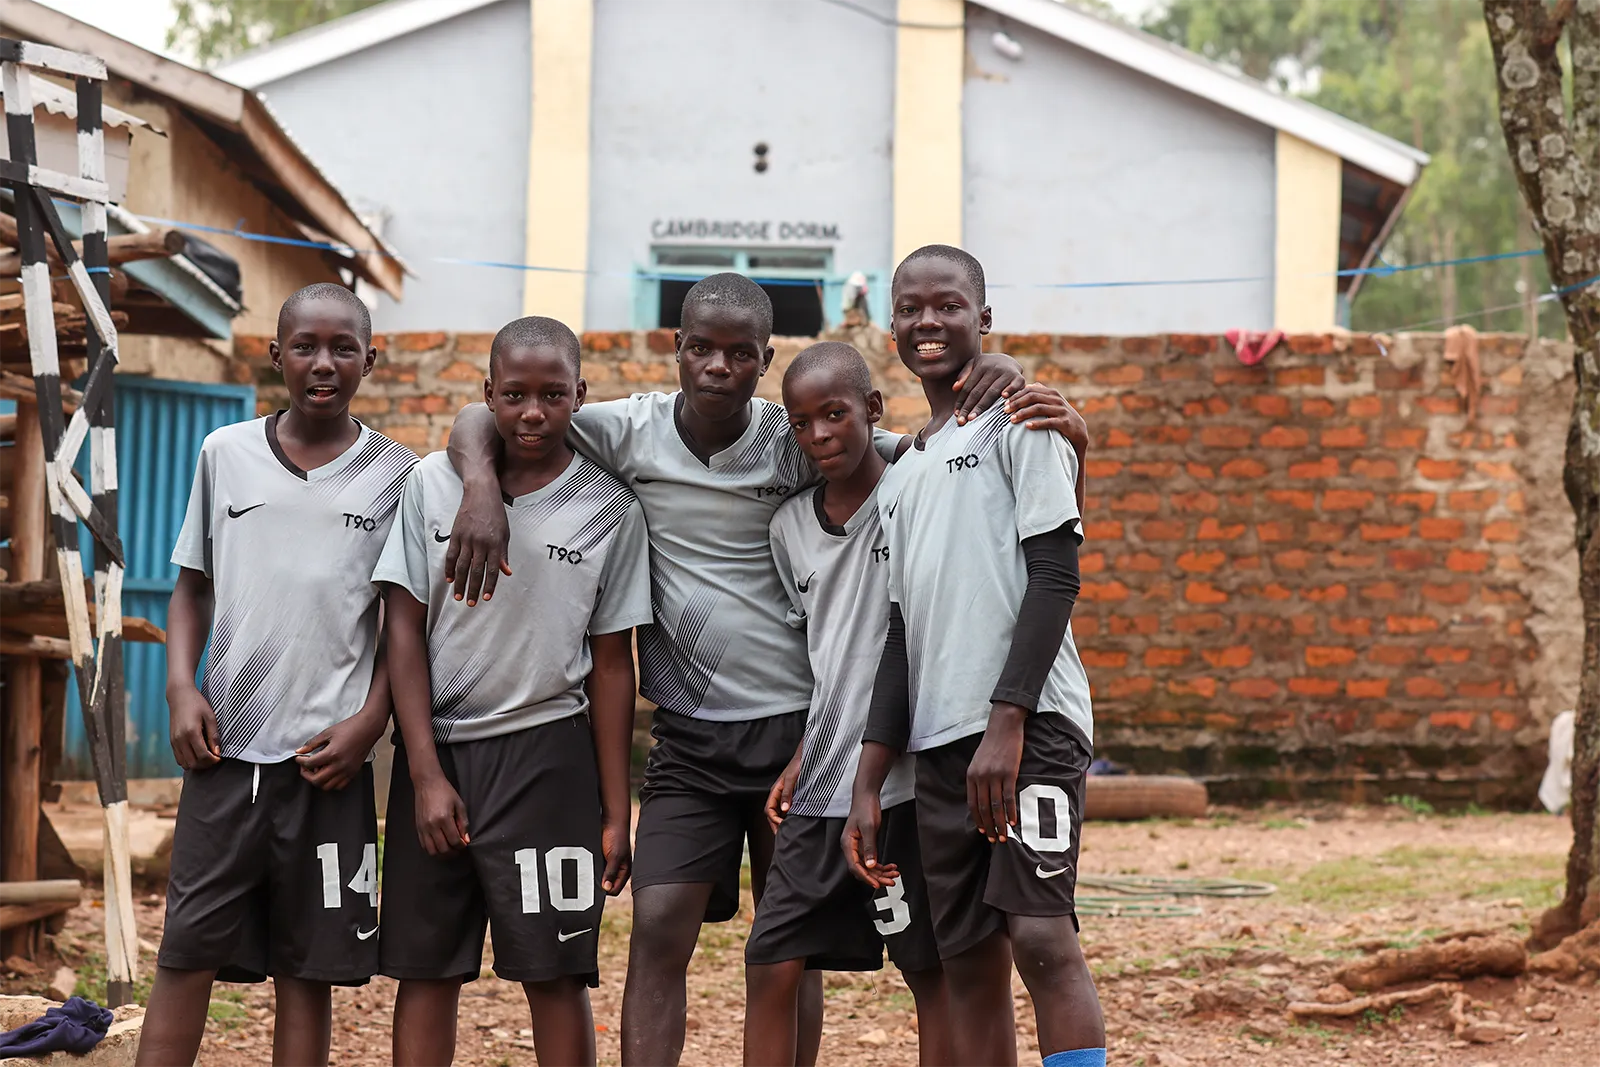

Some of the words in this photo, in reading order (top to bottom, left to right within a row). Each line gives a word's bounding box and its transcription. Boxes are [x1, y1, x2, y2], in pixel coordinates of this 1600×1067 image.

[651, 218, 772, 240] CAMBRIDGE
[945, 453, 979, 474] T90
[753, 485, 790, 498] T90
[342, 512, 376, 532] T90
[546, 544, 583, 565] T90
[871, 545, 890, 563] T9
[995, 784, 1071, 853] 0
[316, 842, 379, 909] 14
[514, 846, 595, 914] 10
